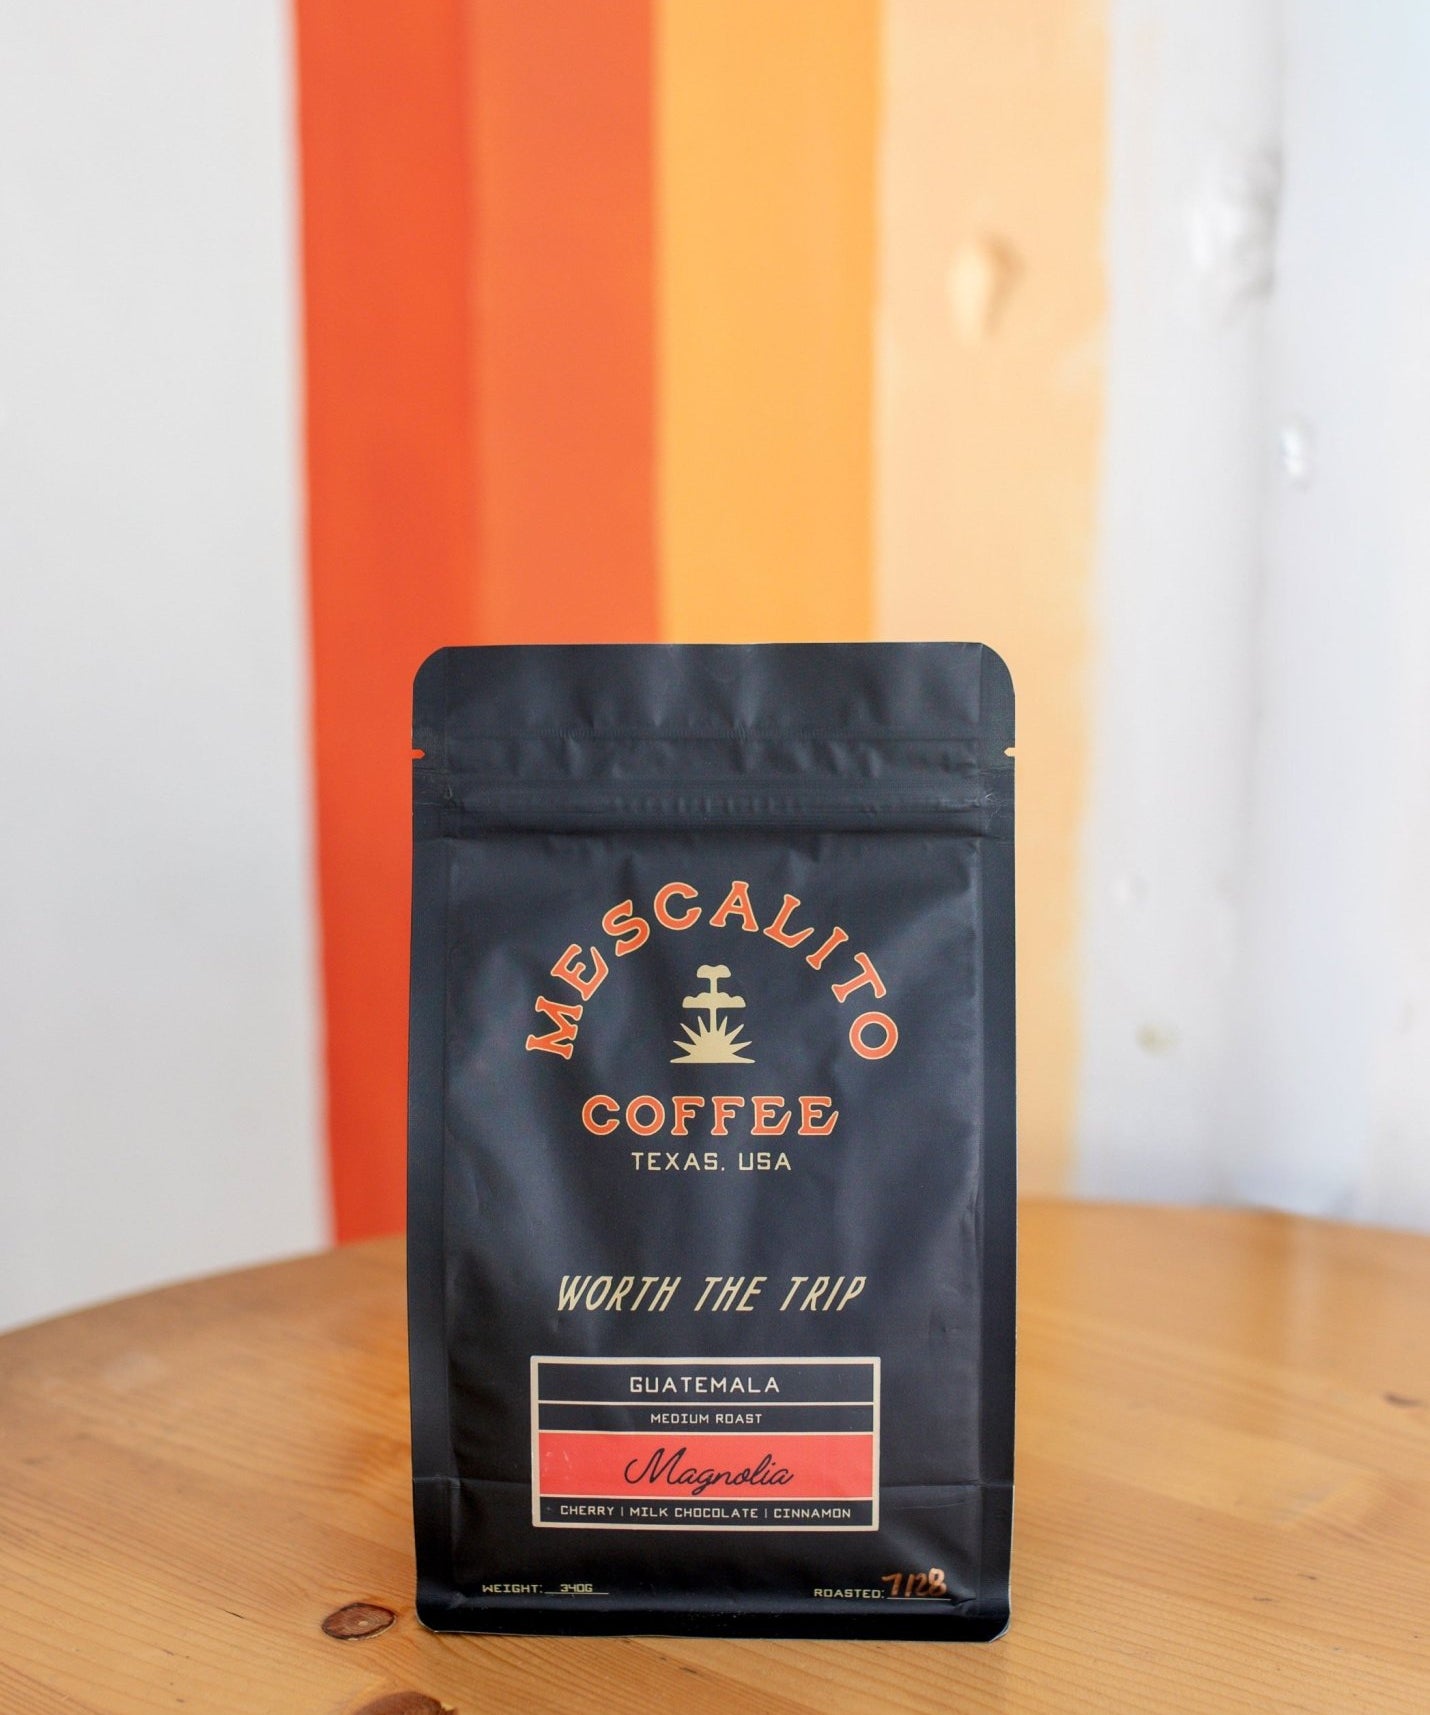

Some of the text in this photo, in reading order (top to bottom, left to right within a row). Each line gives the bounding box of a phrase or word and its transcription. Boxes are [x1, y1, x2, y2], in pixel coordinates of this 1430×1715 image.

[525, 881, 899, 1060] MESCALITO
[582, 1095, 840, 1136] COFFEE
[739, 1152, 791, 1171] USA
[557, 1275, 867, 1312] WORTH THE TRIP
[629, 1377, 780, 1394] GUATEMALA
[650, 1413, 763, 1424] MEDIUM ROAST
[624, 1447, 794, 1496] Magnolia
[560, 1505, 615, 1516] CHERRY
[629, 1506, 669, 1517] MILK
[674, 1507, 758, 1518] CHOCOLATE
[773, 1508, 852, 1519] CINNAMON
[482, 1583, 593, 1594] WEIGHT: 340G
[813, 1588, 885, 1599] ROASTED:
